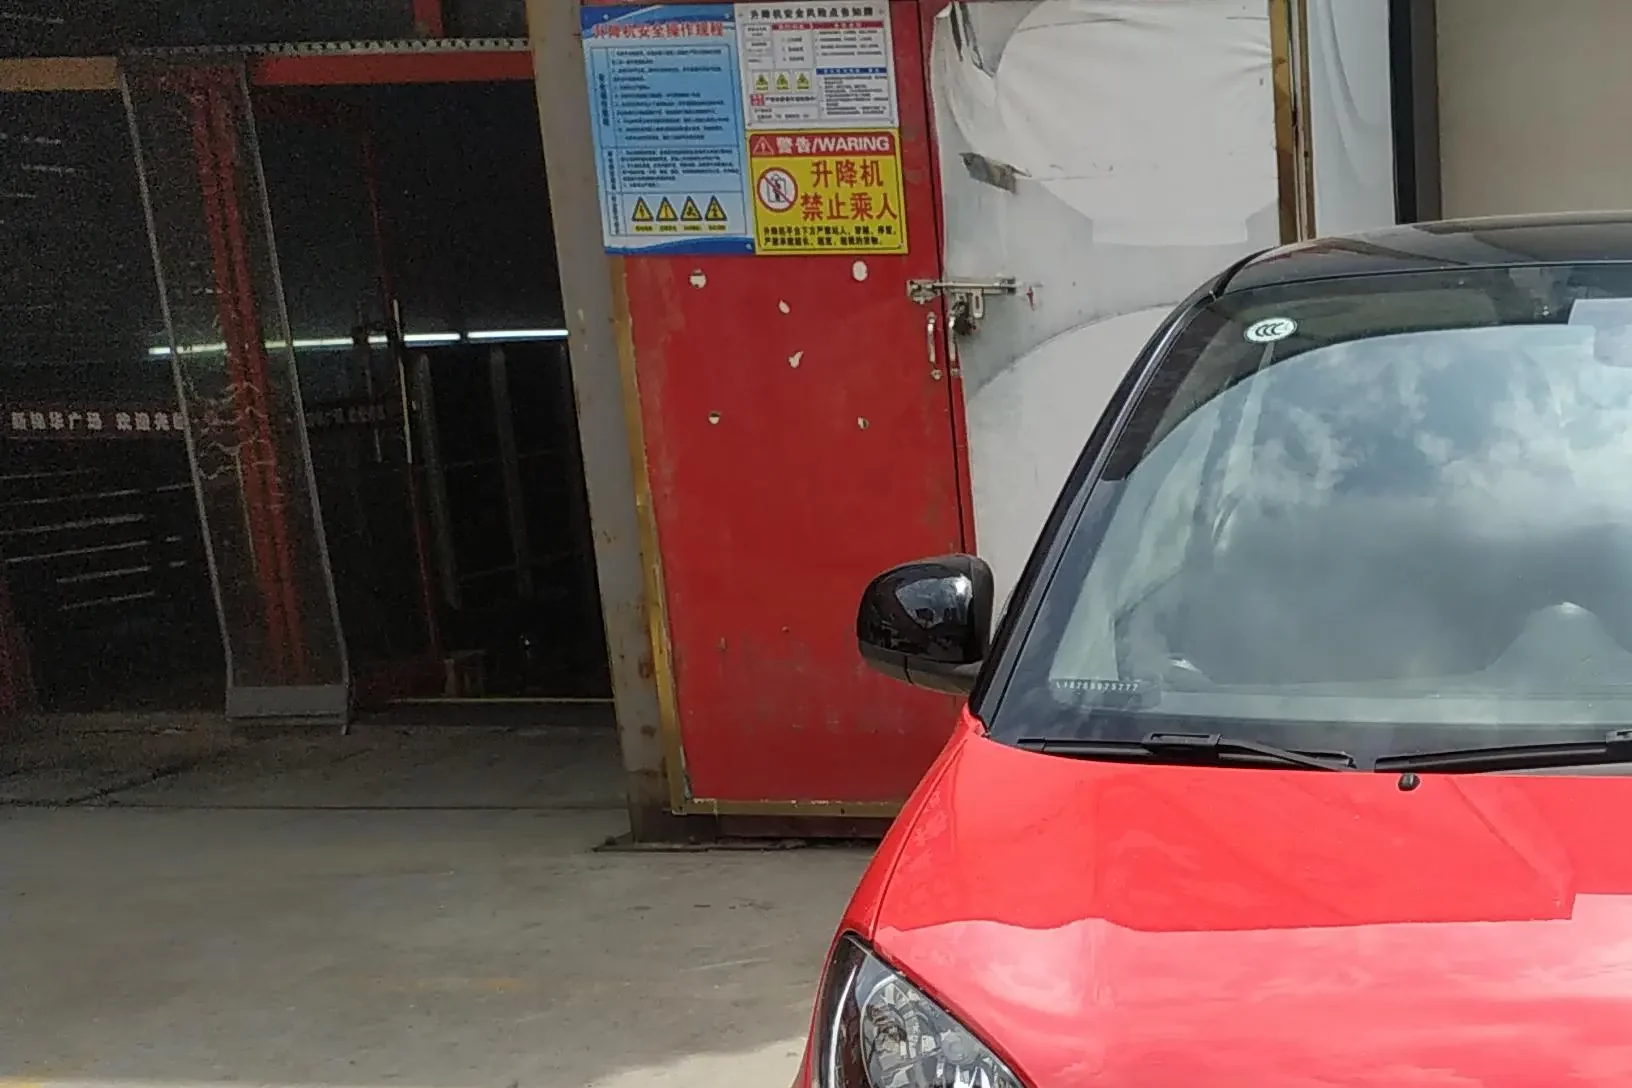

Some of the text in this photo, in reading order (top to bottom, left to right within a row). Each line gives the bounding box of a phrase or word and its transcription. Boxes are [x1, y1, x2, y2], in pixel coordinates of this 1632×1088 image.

[776, 136, 890, 154] 警告/WARING
[811, 159, 884, 188] 升降机
[801, 192, 897, 221] 禁止乘人
